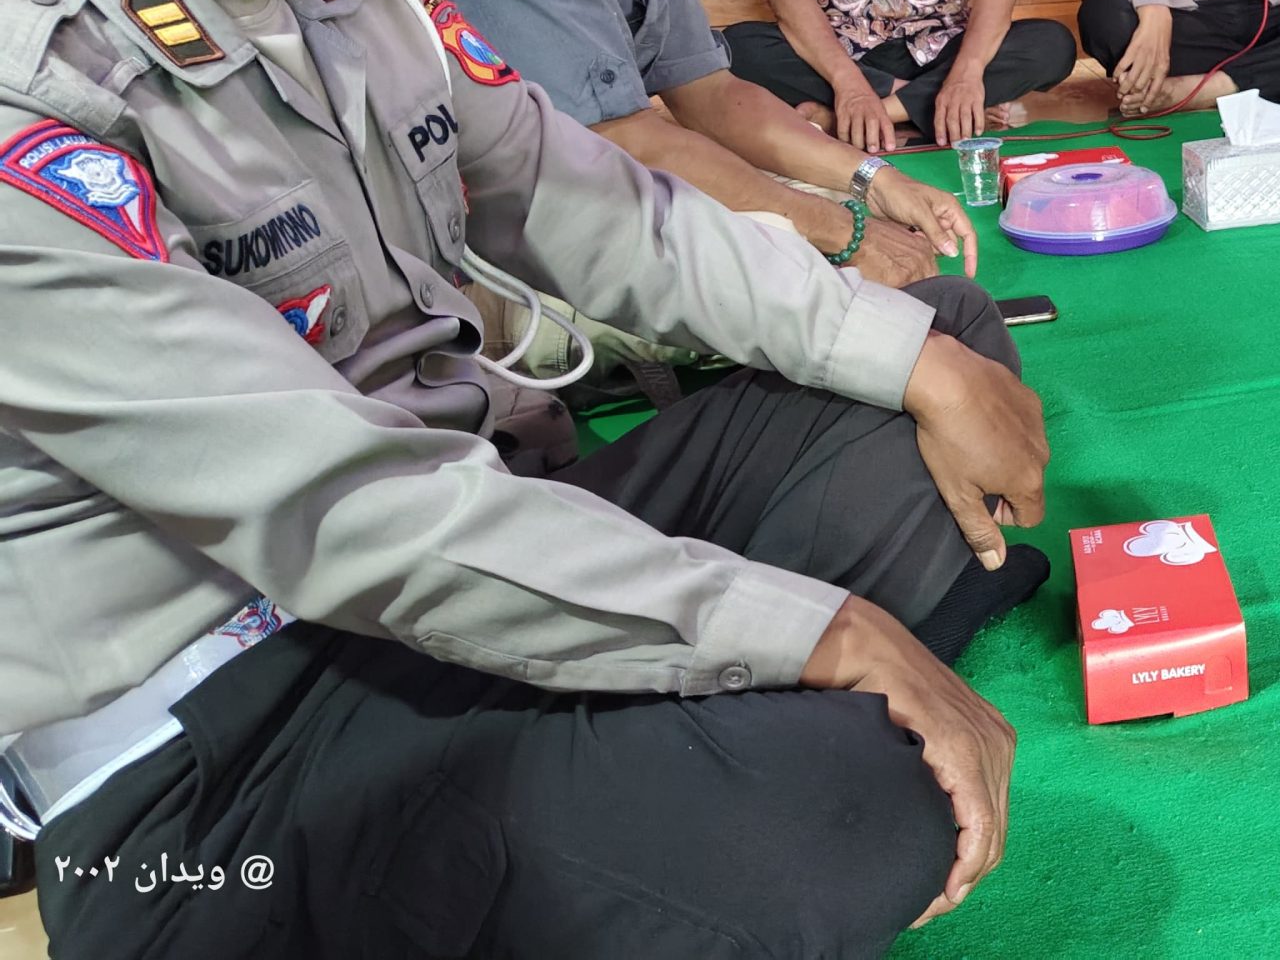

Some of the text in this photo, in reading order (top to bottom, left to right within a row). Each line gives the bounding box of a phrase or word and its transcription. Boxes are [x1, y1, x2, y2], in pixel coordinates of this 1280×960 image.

[1131, 606, 1160, 625] LYLY
[1132, 664, 1206, 685] LYLY BAKERY
